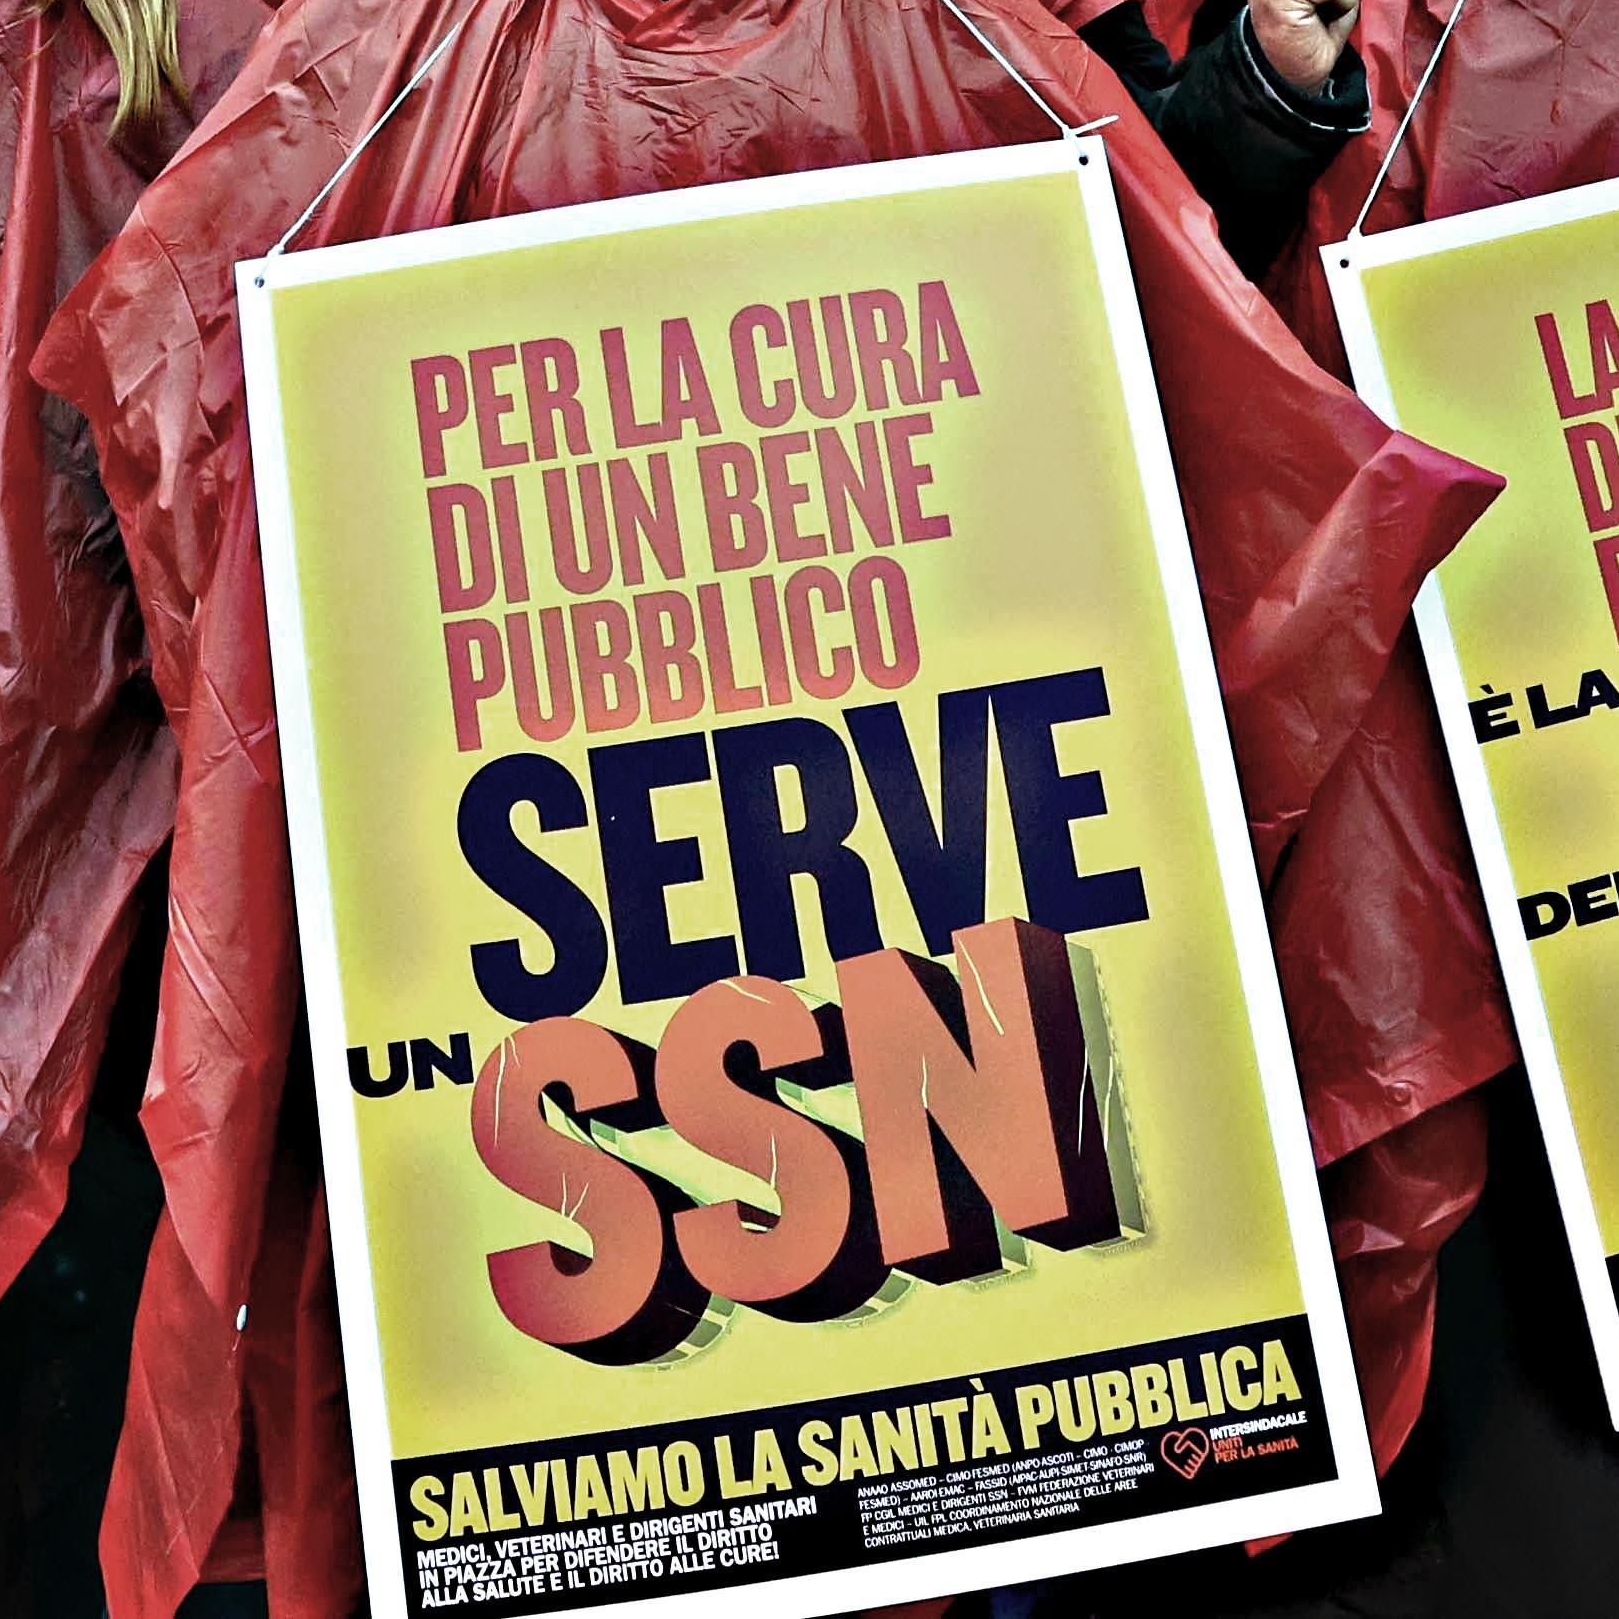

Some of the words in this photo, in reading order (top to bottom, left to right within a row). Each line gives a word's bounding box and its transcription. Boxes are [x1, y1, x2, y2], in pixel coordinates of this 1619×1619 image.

[411, 336, 589, 478] PER
[599, 317, 722, 449] LA
[728, 281, 981, 428] CURA
[427, 475, 529, 614] DI
[541, 452, 685, 595] UN
[696, 413, 952, 573] BENE
[443, 555, 920, 752] PUBBLICO
[1468, 682, 1521, 744] È
[456, 666, 1150, 1023] SERVE
[346, 1033, 474, 1098] UN
[470, 916, 1093, 1356] SSN
[408, 1432, 714, 1548] SALVIAMO
[712, 1422, 789, 1501] LA
[794, 1377, 1000, 1487] SANITÀ
[1026, 1339, 1303, 1448] PUBBLICA
[1208, 1411, 1308, 1440] INTERSINDACALE
[416, 1541, 491, 1573] MEDICI,
[494, 1525, 607, 1560] VETERINARI
[611, 1524, 625, 1543] E
[629, 1509, 725, 1541] DIRIGENTI
[728, 1495, 817, 1526] SANITARI
[419, 1568, 439, 1589] IN
[443, 1557, 516, 1586] PIAZZA
[520, 1552, 559, 1576] PER
[563, 1536, 671, 1570] DIFENDERE
[675, 1534, 693, 1553] IL
[697, 1522, 773, 1551] DIRITTO
[420, 1584, 468, 1609] ALLA
[472, 1573, 545, 1602] SALUTE
[549, 1572, 563, 1591] E
[567, 1569, 585, 1588] IL
[589, 1557, 664, 1586] DIRITTO
[668, 1550, 716, 1574] ALLE
[719, 1541, 779, 1567] CURE!
